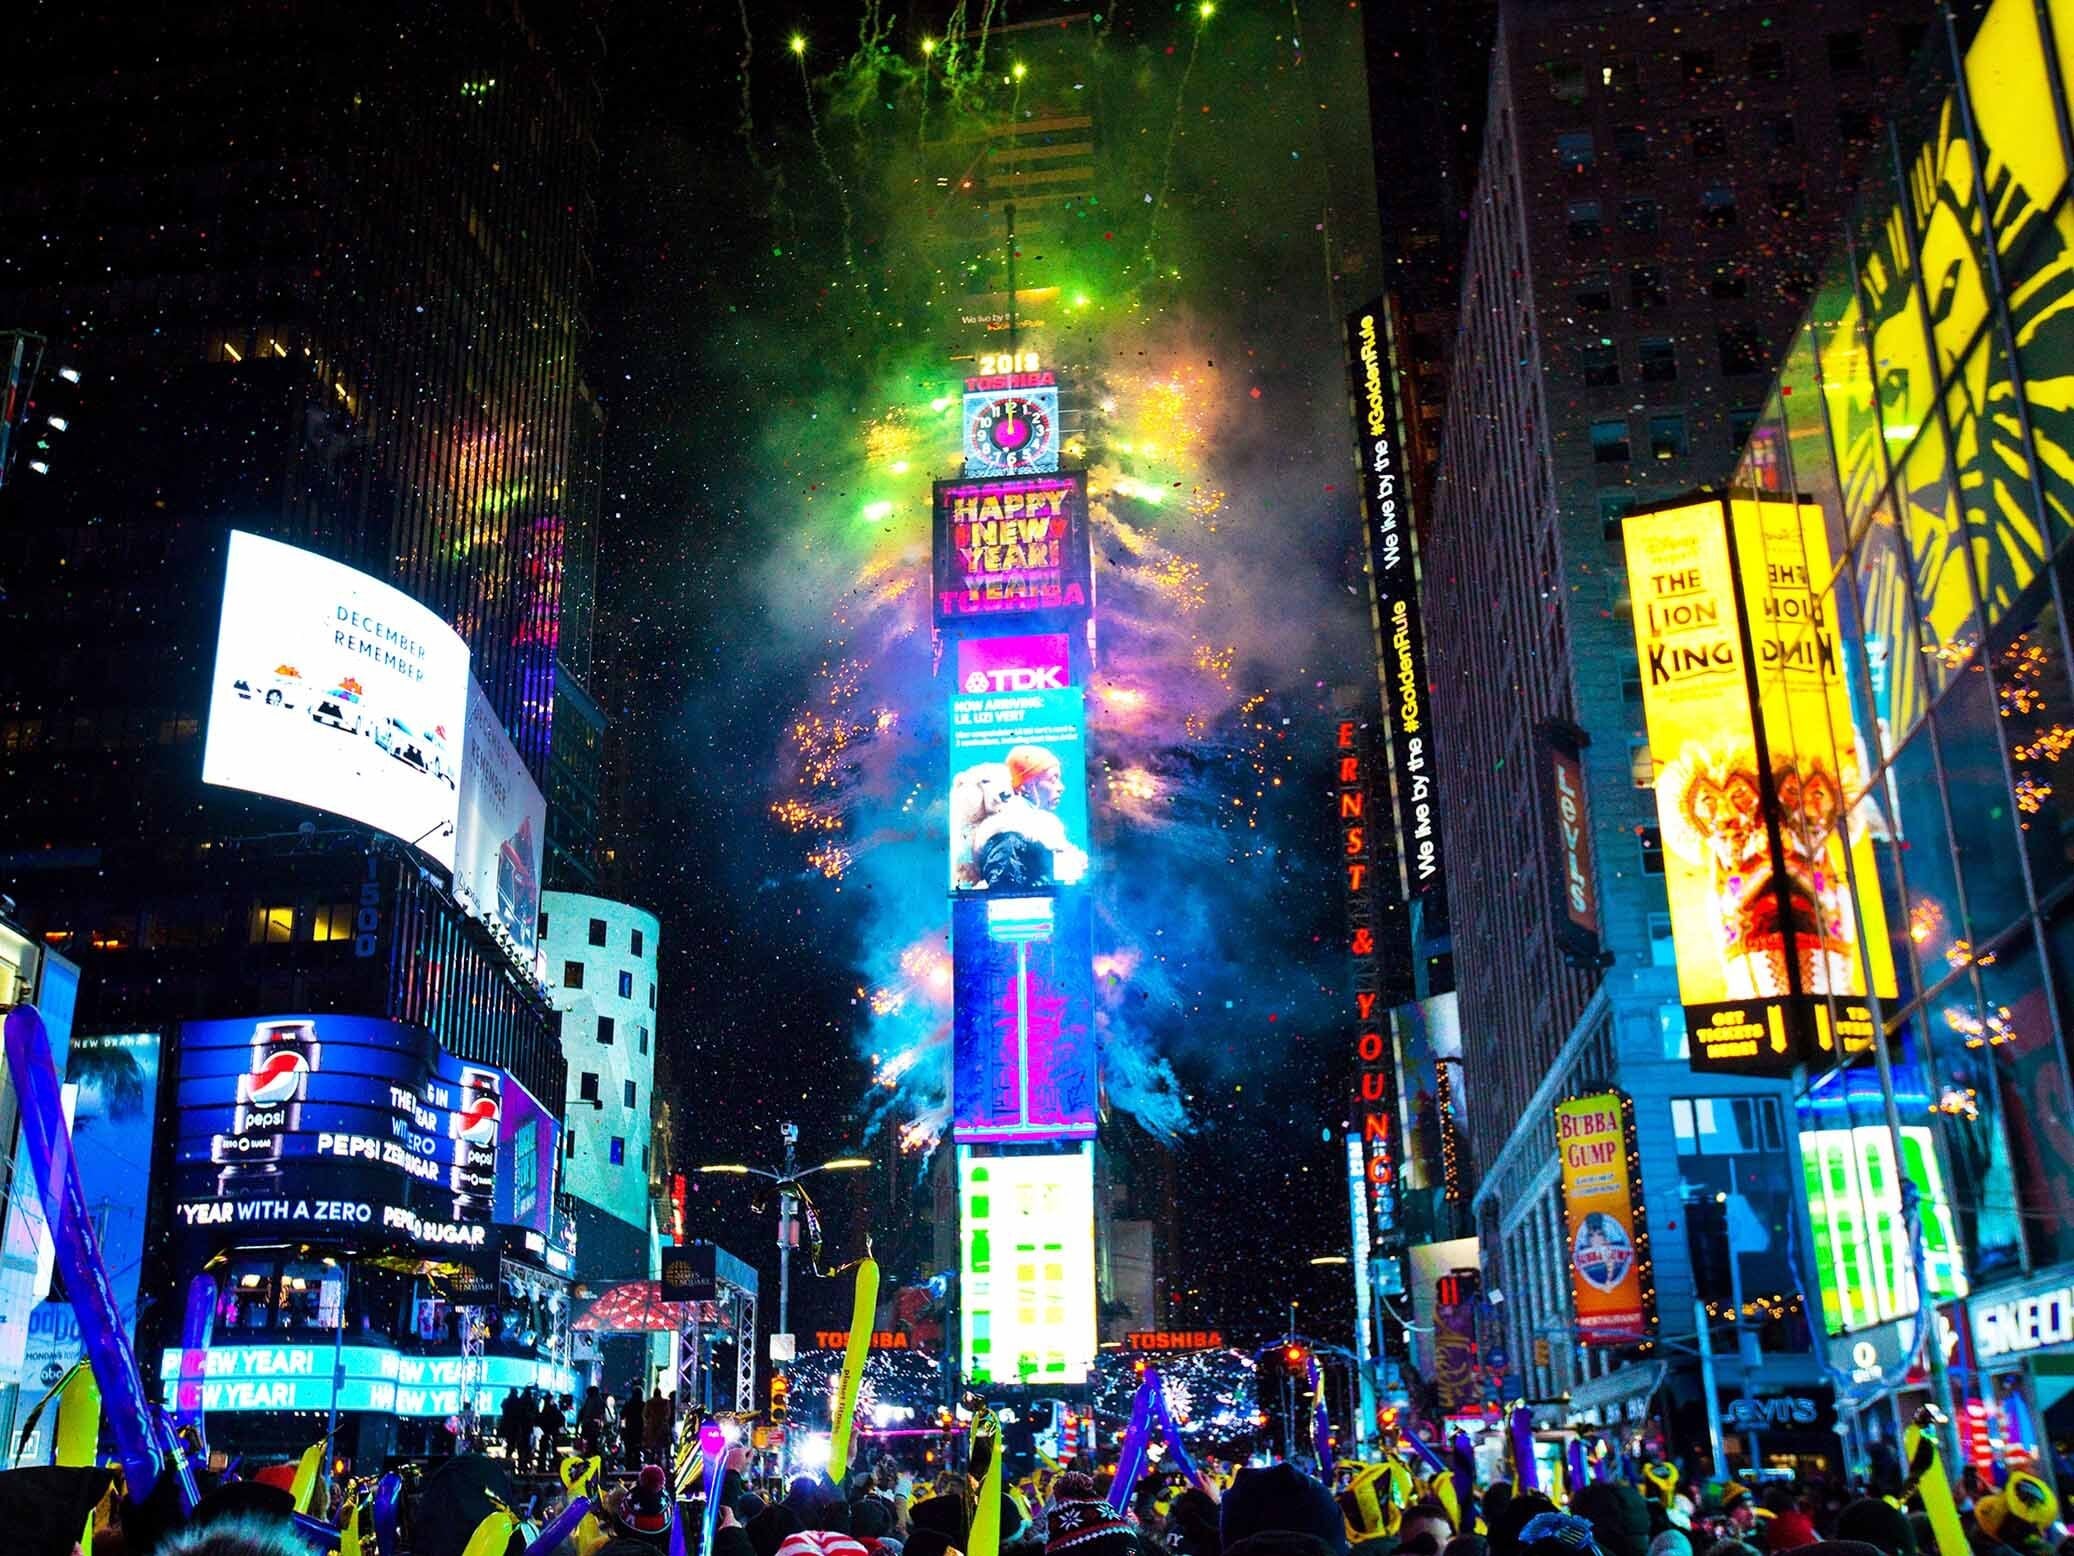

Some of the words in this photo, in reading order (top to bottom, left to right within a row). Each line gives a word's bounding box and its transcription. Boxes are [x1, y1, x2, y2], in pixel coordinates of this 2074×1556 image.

[979, 352, 1040, 376] 2018
[1359, 313, 1386, 437] #GoldenRule
[964, 371, 1056, 391] TOSHIBA
[1374, 439, 1391, 473] the
[1377, 474, 1396, 500] by
[953, 490, 1069, 523] HAPPY
[1380, 499, 1398, 533] live
[970, 516, 1050, 547] NEW
[1383, 533, 1401, 570] We
[1651, 568, 1702, 594] THE
[336, 604, 425, 661] DECEMBER
[1647, 598, 1719, 638] LION
[334, 629, 424, 683] REMEMBER
[1391, 599, 1421, 734] #GoldenRule
[1647, 642, 1734, 686] KING
[986, 665, 1064, 693] TDK
[1406, 736, 1425, 773] the
[1411, 775, 1430, 803] by
[1337, 721, 1367, 892] ERNST
[1414, 803, 1433, 840] live
[1416, 840, 1437, 881] We
[1351, 927, 1374, 956] &
[74, 1039, 98, 1049] NEW
[1356, 991, 1393, 1183] YOUNG
[245, 1110, 286, 1130] pepsi
[1560, 1110, 1618, 1140] BUBBA
[318, 1133, 380, 1161] PEPSI
[468, 1150, 493, 1166] pepsi
[1567, 1141, 1617, 1170] GUMP
[237, 1200, 289, 1221] WITH
[293, 1200, 310, 1220] A
[314, 1201, 372, 1223] ZERO
[423, 1221, 486, 1245] SUGAR
[1127, 1331, 1222, 1350] TOSHIBA
[40, 1365, 63, 1381] abc
[242, 1350, 314, 1375] YEAR!
[226, 1383, 297, 1408] YEAR!
